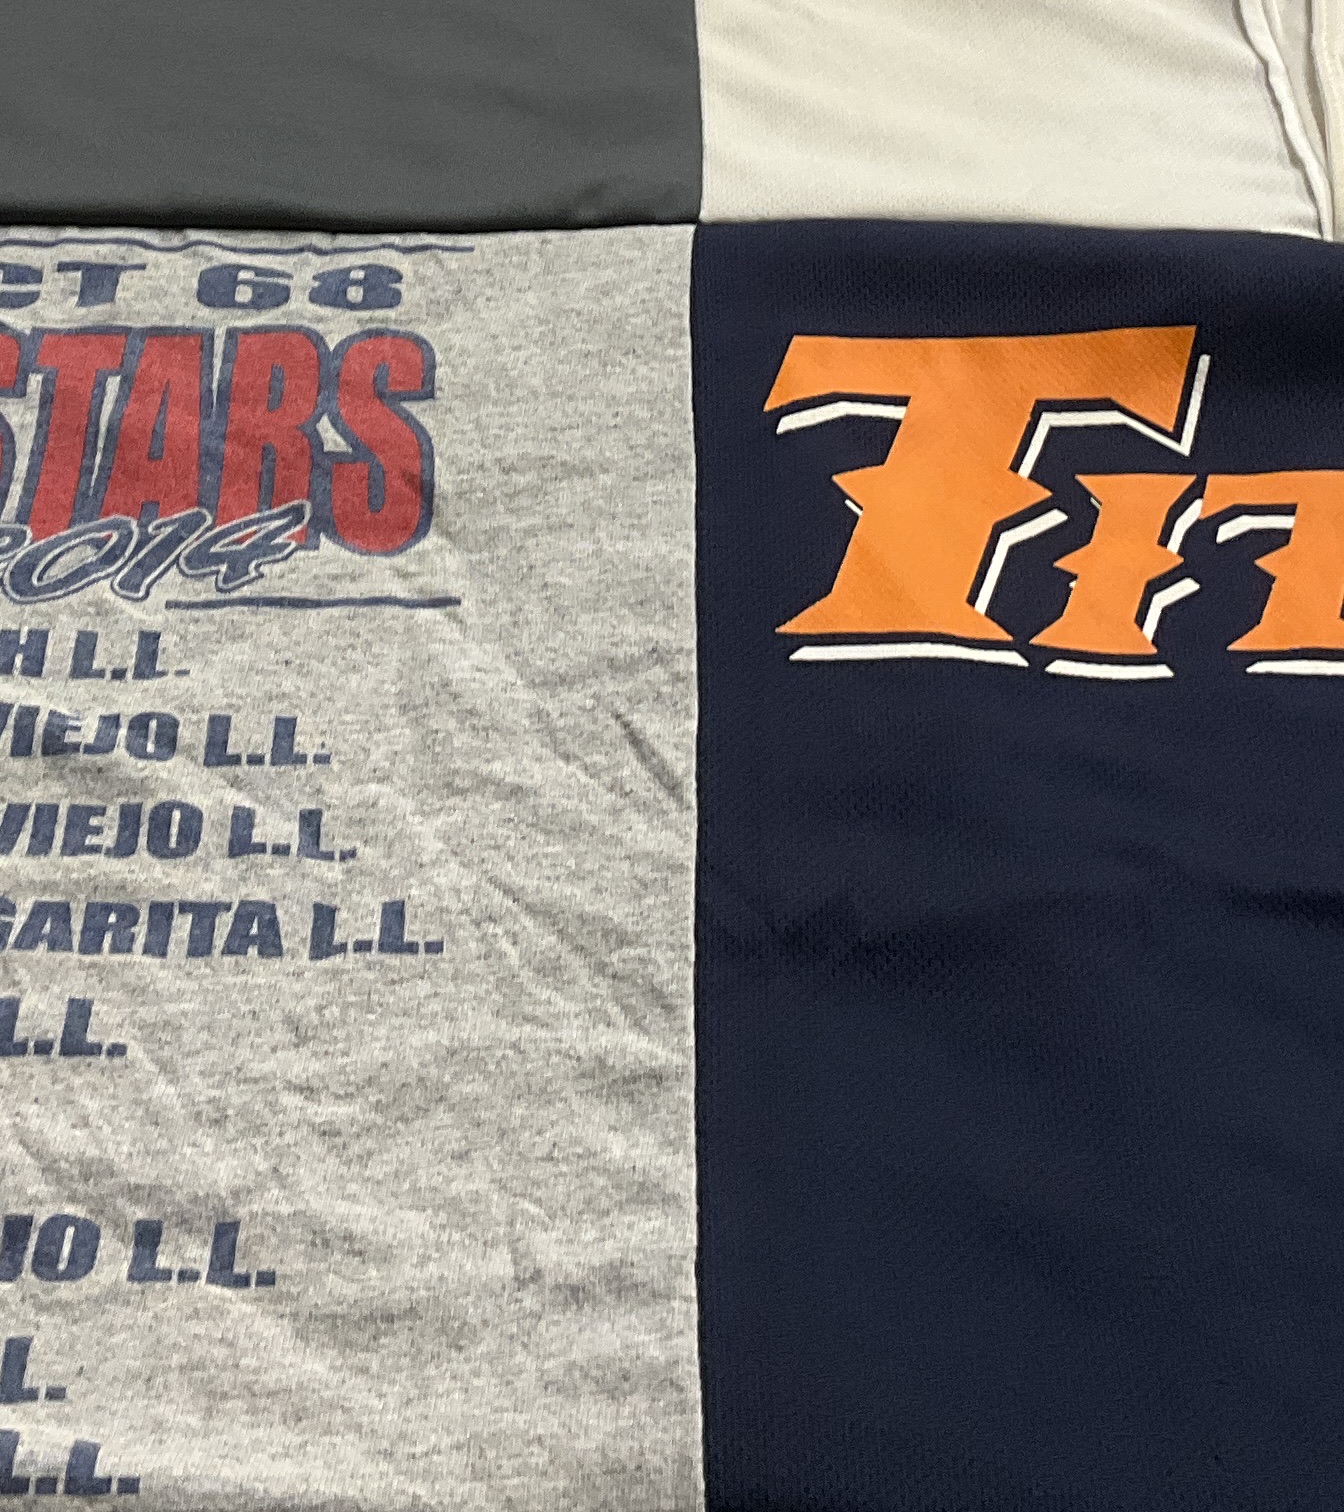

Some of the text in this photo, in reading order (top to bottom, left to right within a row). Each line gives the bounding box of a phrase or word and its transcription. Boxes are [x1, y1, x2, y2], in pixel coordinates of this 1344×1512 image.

[196, 259, 406, 313] 68
[66, 630, 191, 681] L.L.
[203, 714, 333, 767] L.L.
[228, 806, 359, 863] L.L.
[308, 899, 445, 962] L.L.
[128, 1220, 278, 1288] L.L.
